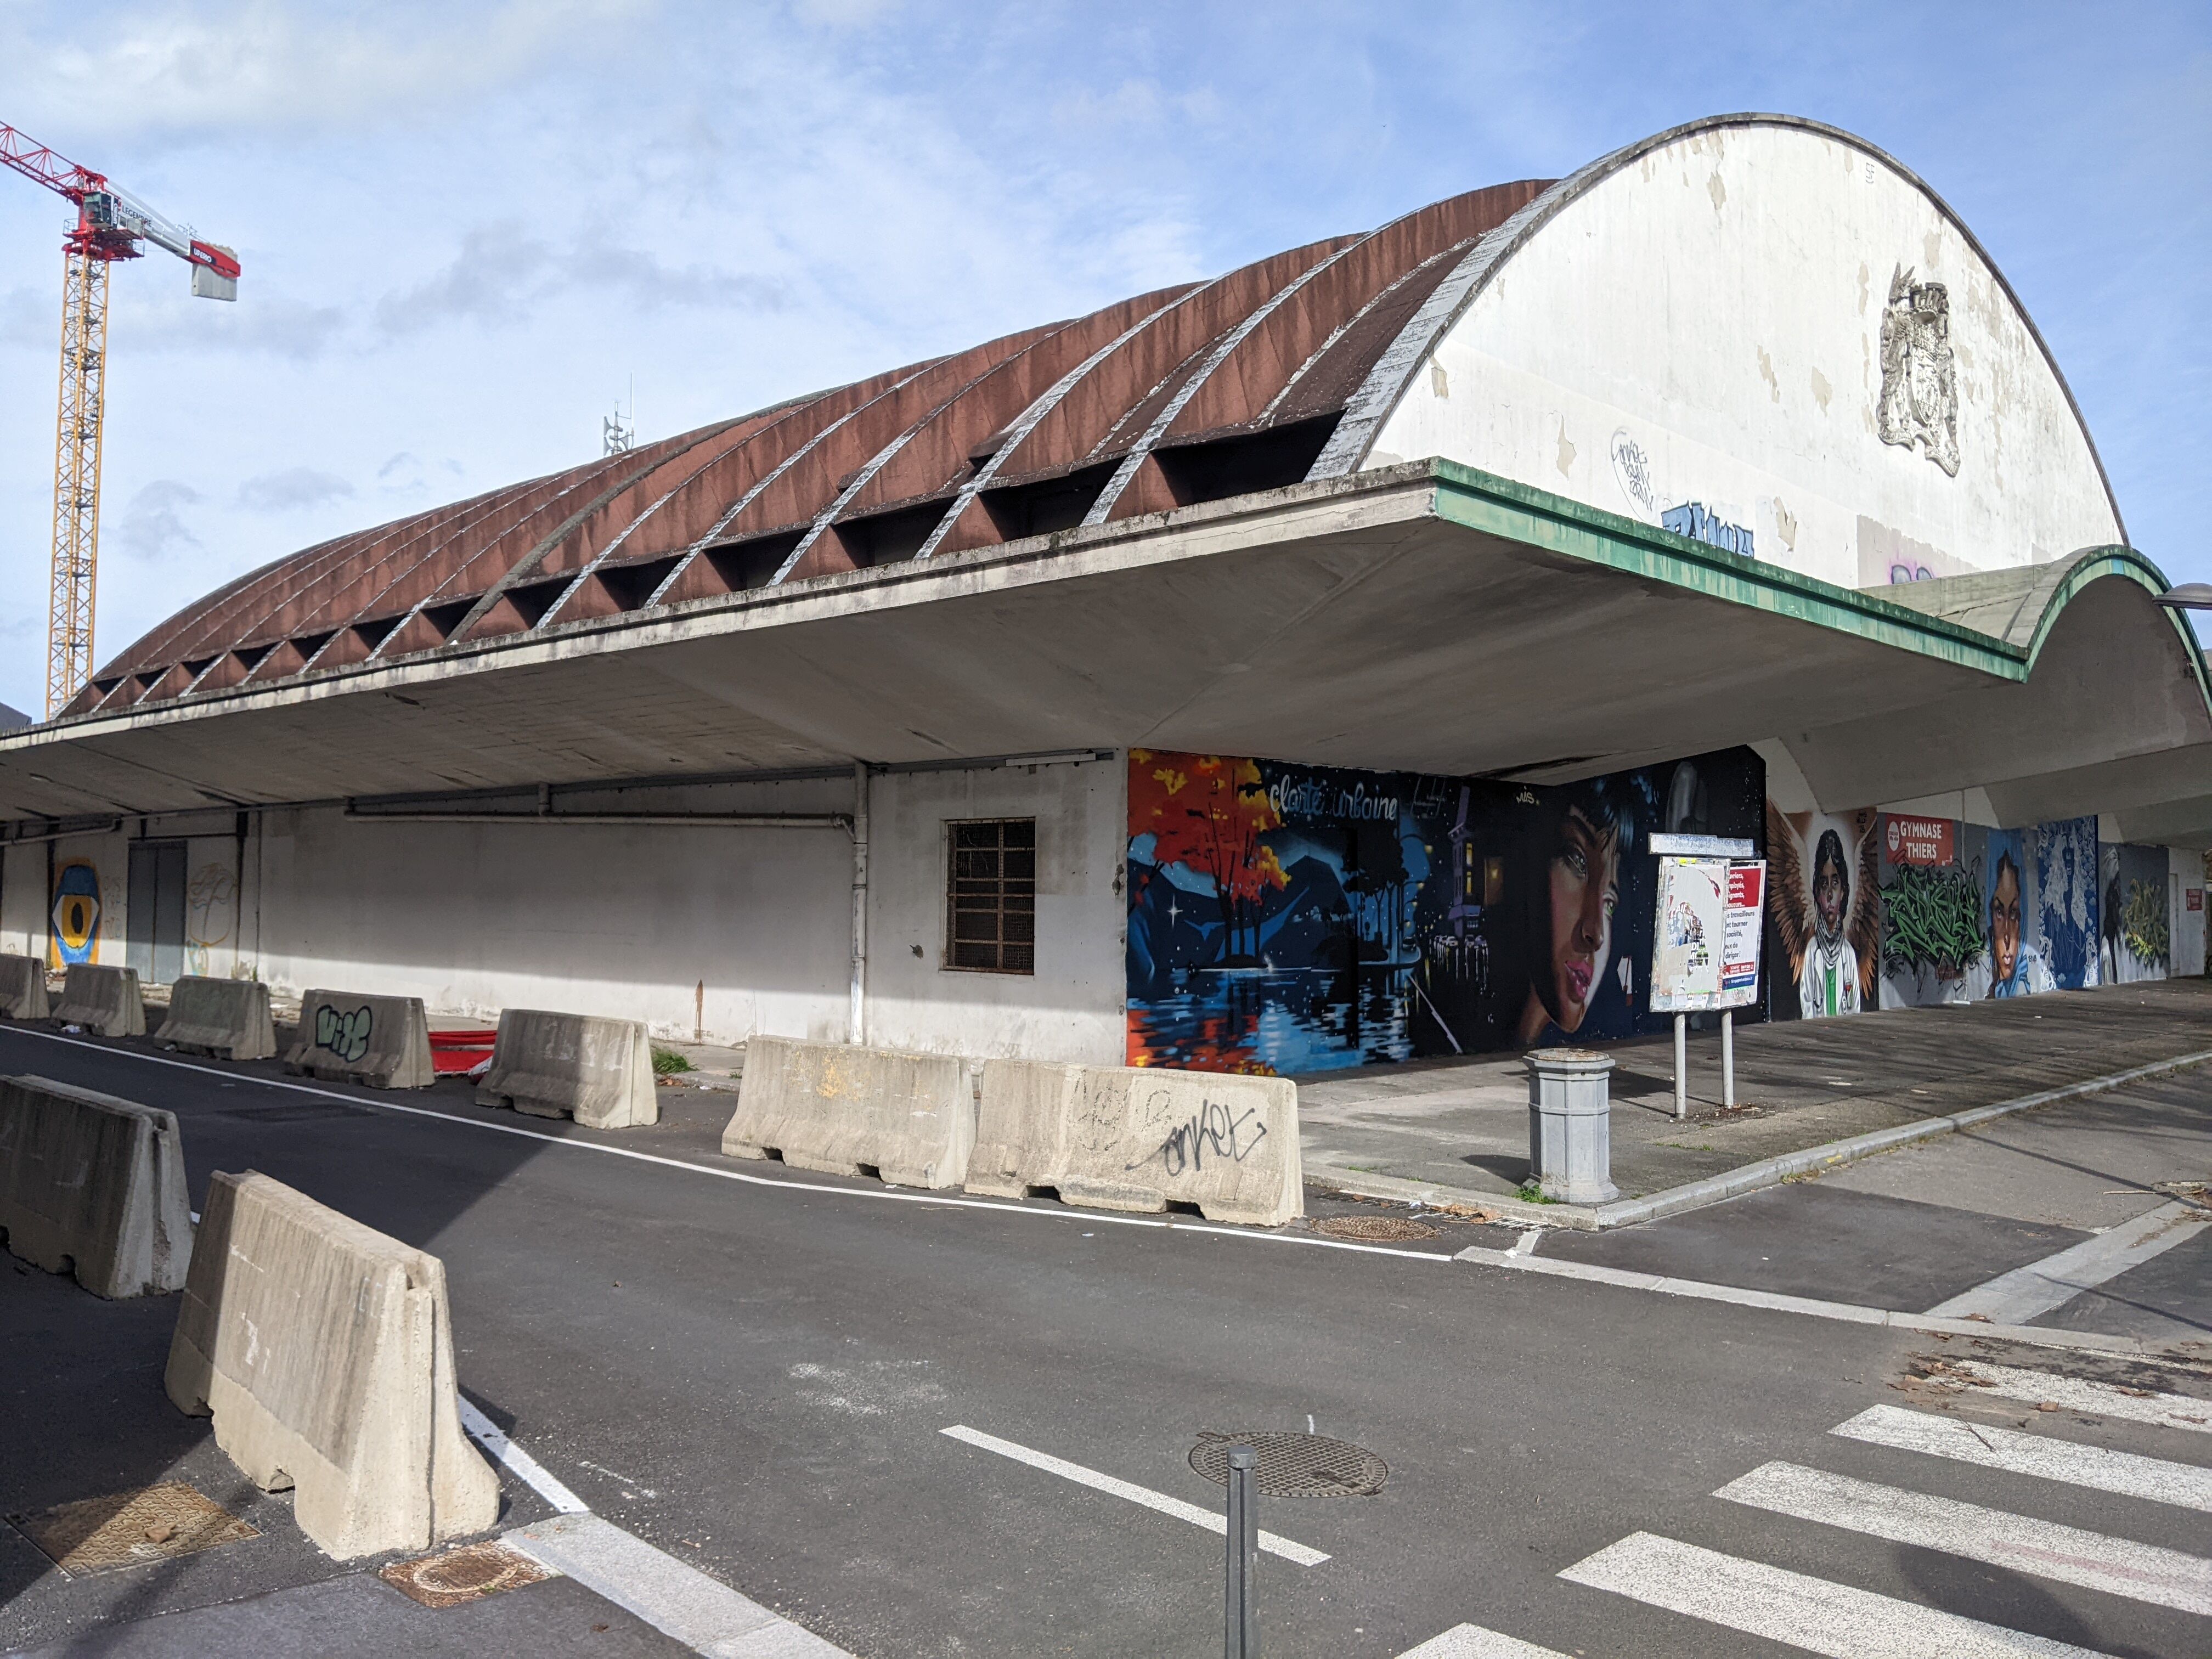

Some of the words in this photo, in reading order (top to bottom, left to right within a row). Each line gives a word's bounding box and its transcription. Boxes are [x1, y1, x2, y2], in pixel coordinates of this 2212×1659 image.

[1900, 820, 1942, 839] GYMNASE
[1906, 842, 1937, 859] THIERS
[1731, 910, 1755, 918] travailleurs
